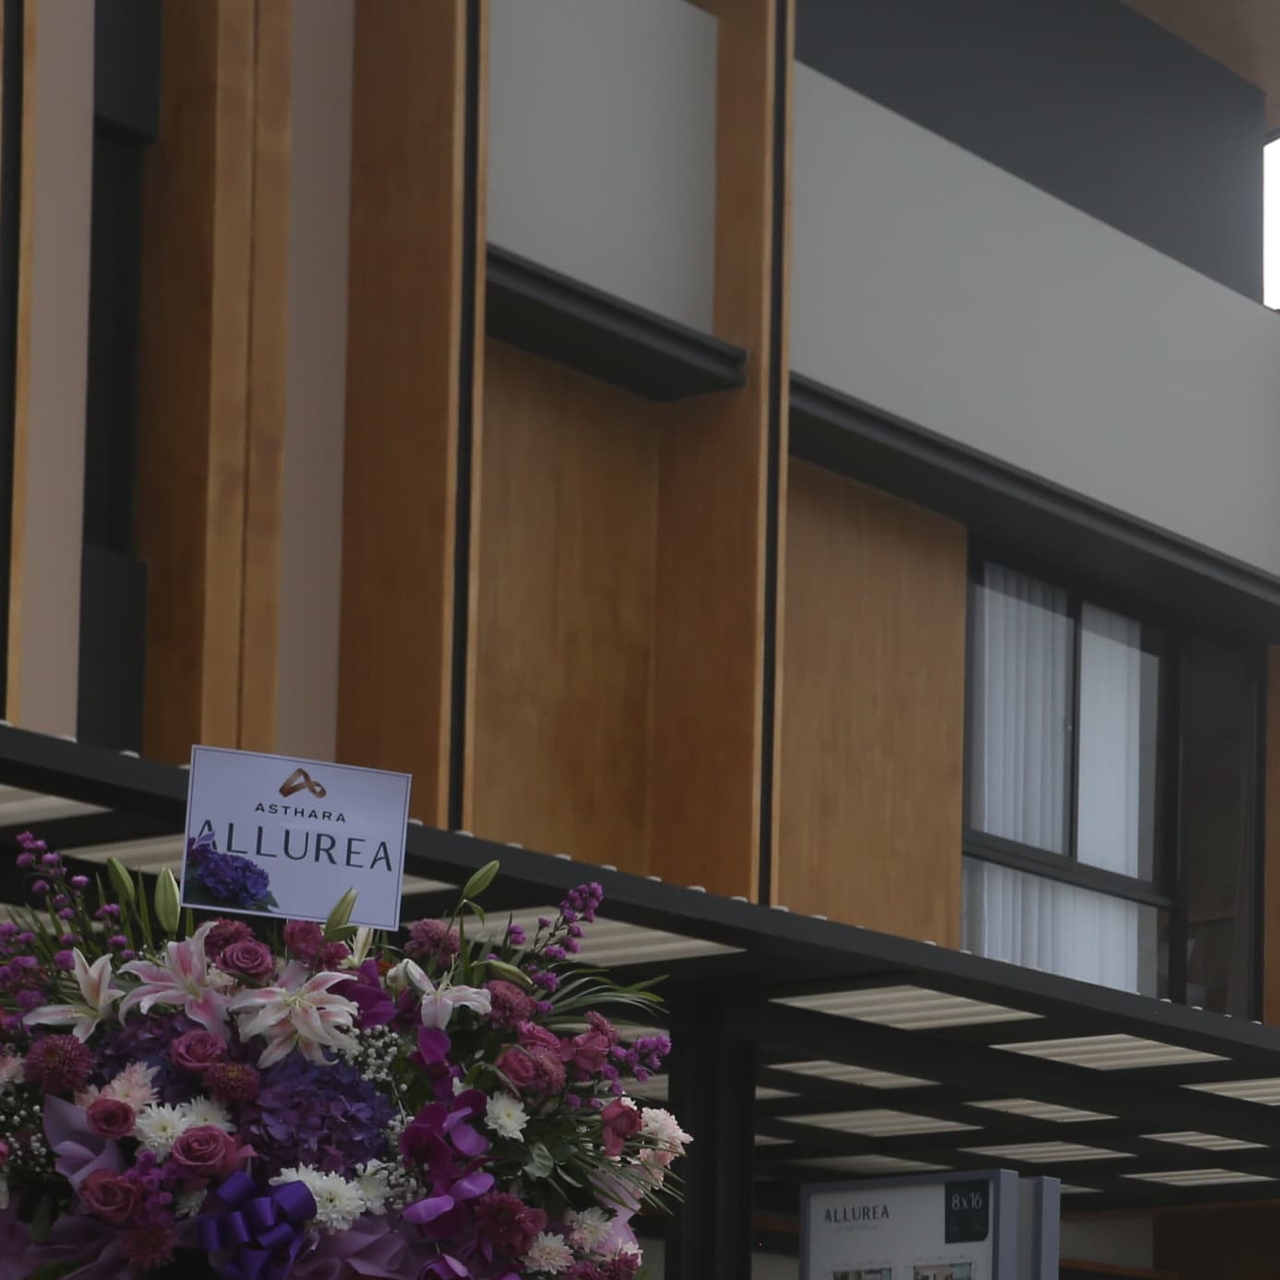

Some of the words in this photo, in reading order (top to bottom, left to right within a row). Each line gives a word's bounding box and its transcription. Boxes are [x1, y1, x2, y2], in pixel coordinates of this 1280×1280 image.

[254, 802, 346, 823] ASTHARA
[197, 819, 392, 872] ALLUREA
[824, 1204, 890, 1223] ALLUREA
